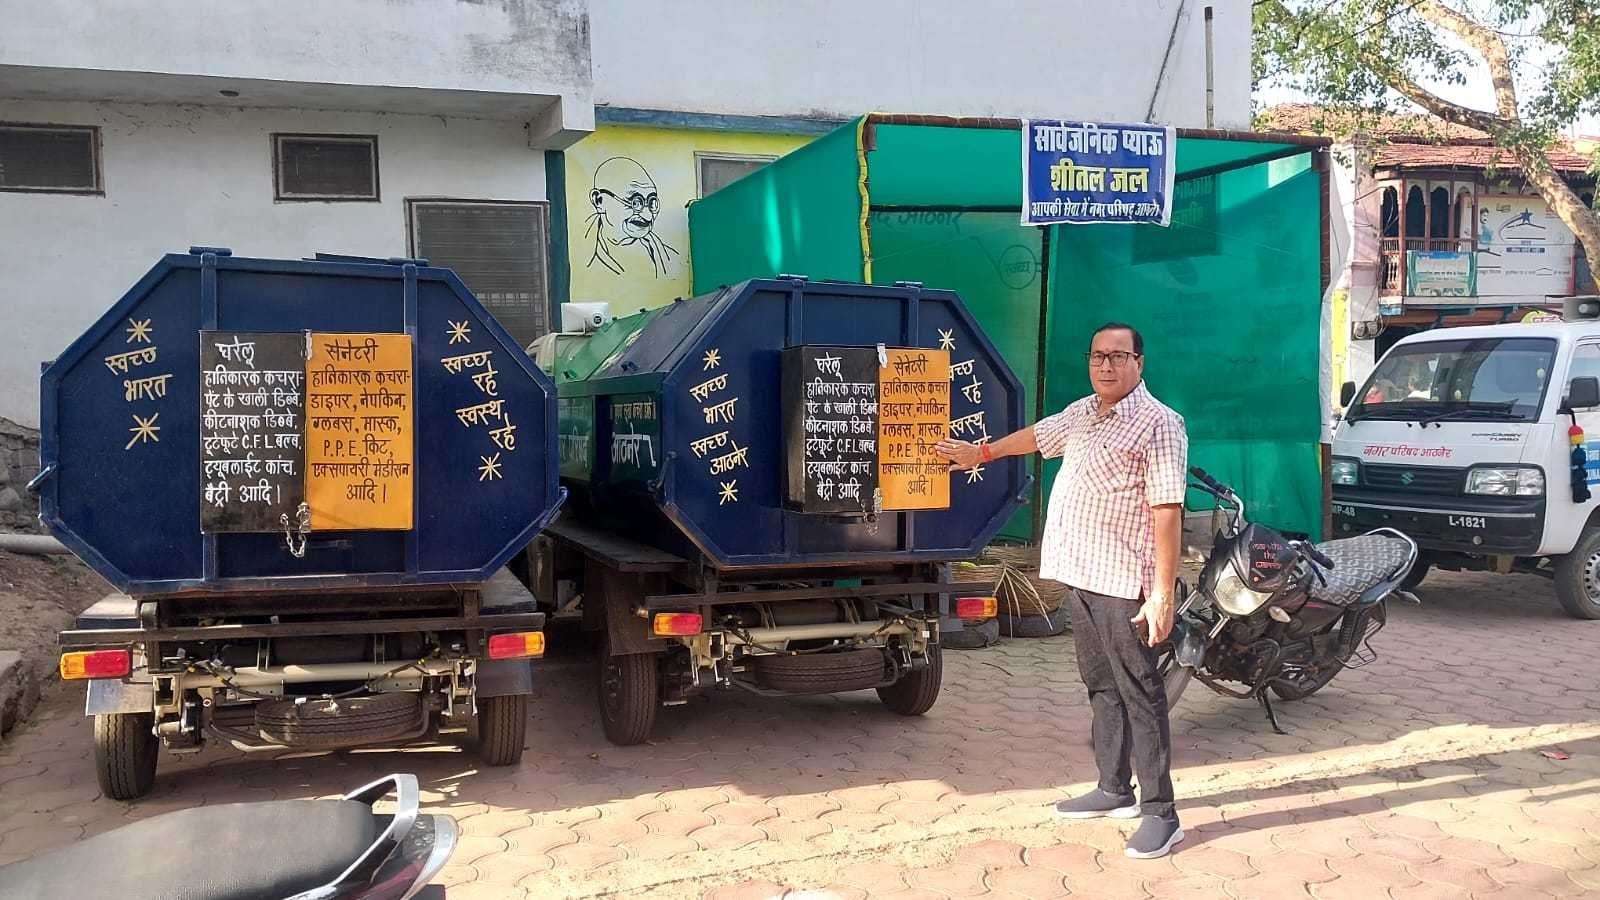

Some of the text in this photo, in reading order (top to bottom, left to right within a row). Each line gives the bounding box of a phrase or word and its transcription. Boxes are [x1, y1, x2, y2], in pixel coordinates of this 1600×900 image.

[1122, 129, 1163, 155] प्याऊ
[1050, 158, 1106, 192] शीतल
[1110, 168, 1149, 192] जल
[1031, 198, 1061, 217] आपकी
[1063, 197, 1080, 216] सेवा
[105, 346, 156, 375] स्वच्छ
[215, 336, 255, 369] घरेलू
[324, 338, 379, 363] सेनेटरी
[441, 351, 493, 374] स्वच्छ
[203, 364, 260, 387] हानिकारक
[311, 364, 371, 387] हानिकारक
[814, 352, 843, 382] घरेलू
[894, 353, 928, 376] सेनेटरी
[123, 374, 173, 401] भारत
[472, 360, 498, 396] रहे
[689, 374, 728, 402] स्वच्छ
[806, 377, 851, 398] हानिकारक
[882, 377, 926, 397] हानिकारक
[961, 374, 983, 403] रहे
[223, 387, 235, 408] के
[237, 387, 269, 407] खाली
[703, 397, 738, 424] भारत
[824, 399, 832, 414] के
[833, 397, 858, 414] खाली
[203, 408, 260, 433] कीटनाशक
[455, 400, 505, 427] स्वस्थ
[805, 415, 848, 437] कीटनाशक
[949, 411, 985, 437] स्वस्थ
[489, 412, 516, 450] रहे
[690, 431, 728, 458] स्वच्छ
[710, 440, 749, 475] आठनेर
[838, 477, 862, 503] आदि
[1448, 515, 1486, 529] L-1821
